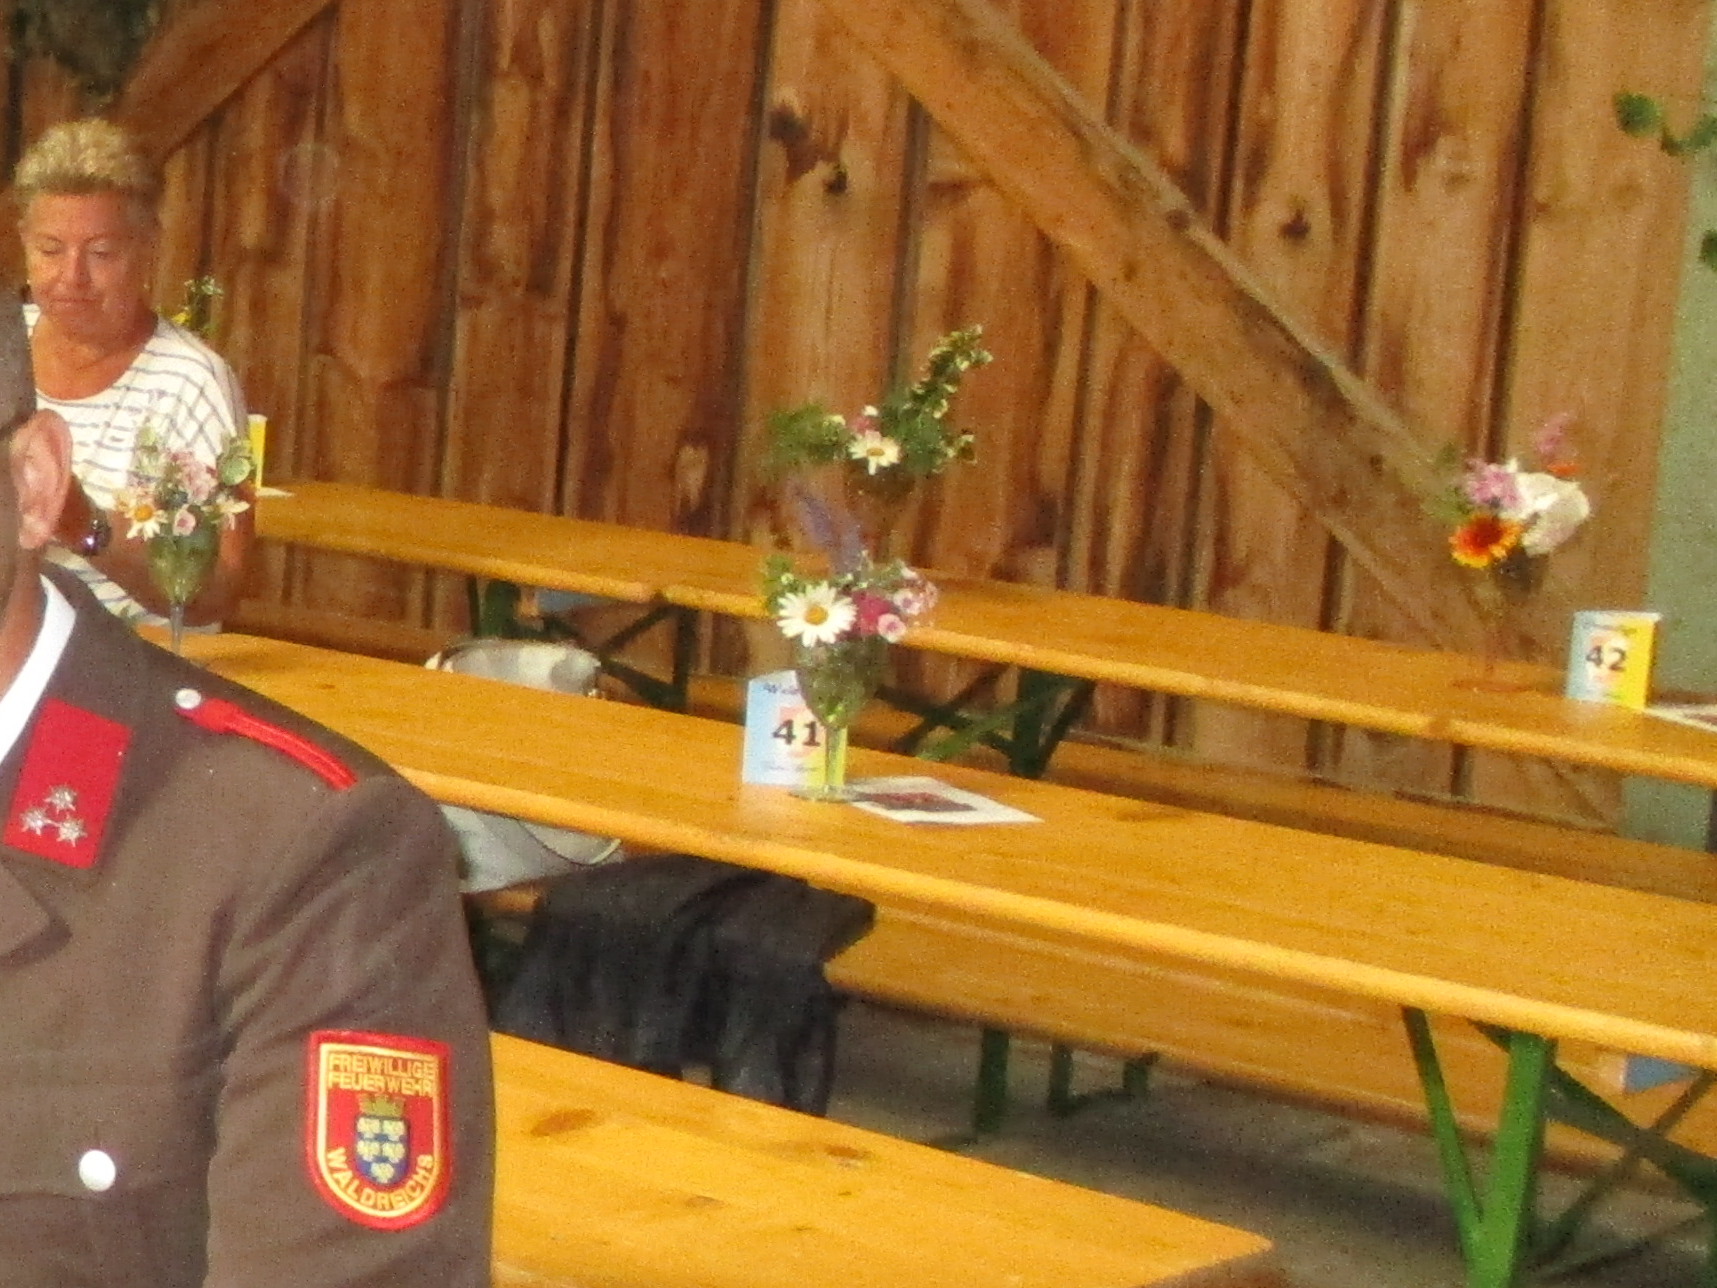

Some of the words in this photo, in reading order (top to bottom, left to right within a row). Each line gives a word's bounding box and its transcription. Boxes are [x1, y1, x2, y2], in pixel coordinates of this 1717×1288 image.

[1585, 644, 1627, 673] 42
[772, 718, 822, 748] 41
[328, 1053, 435, 1079] FREIWILLIGE
[328, 1071, 434, 1098] FEUERWEHR
[326, 1146, 435, 1210] WALDREICHS
